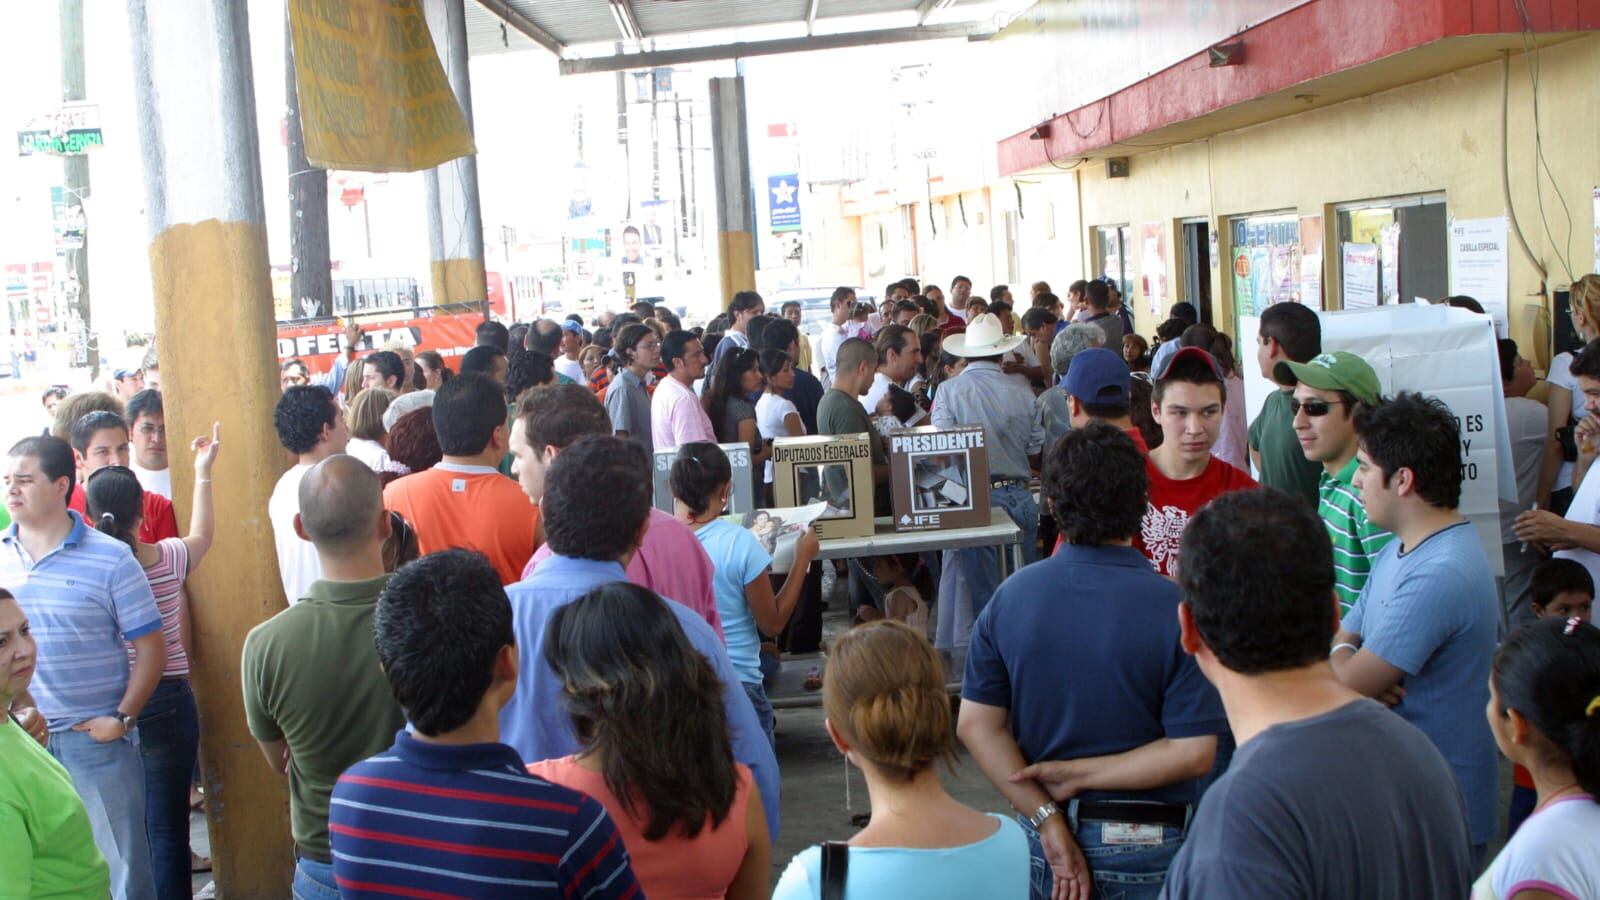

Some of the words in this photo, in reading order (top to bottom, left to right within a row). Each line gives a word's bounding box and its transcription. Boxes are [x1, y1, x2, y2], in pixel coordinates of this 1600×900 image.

[1466, 414, 1483, 432] ES
[892, 431, 984, 453] PRESIDENTE
[1463, 439, 1471, 456] Y
[774, 446, 822, 463] DIPUTADOS
[824, 444, 870, 460] FEDERALES
[914, 514, 940, 525] IFE
